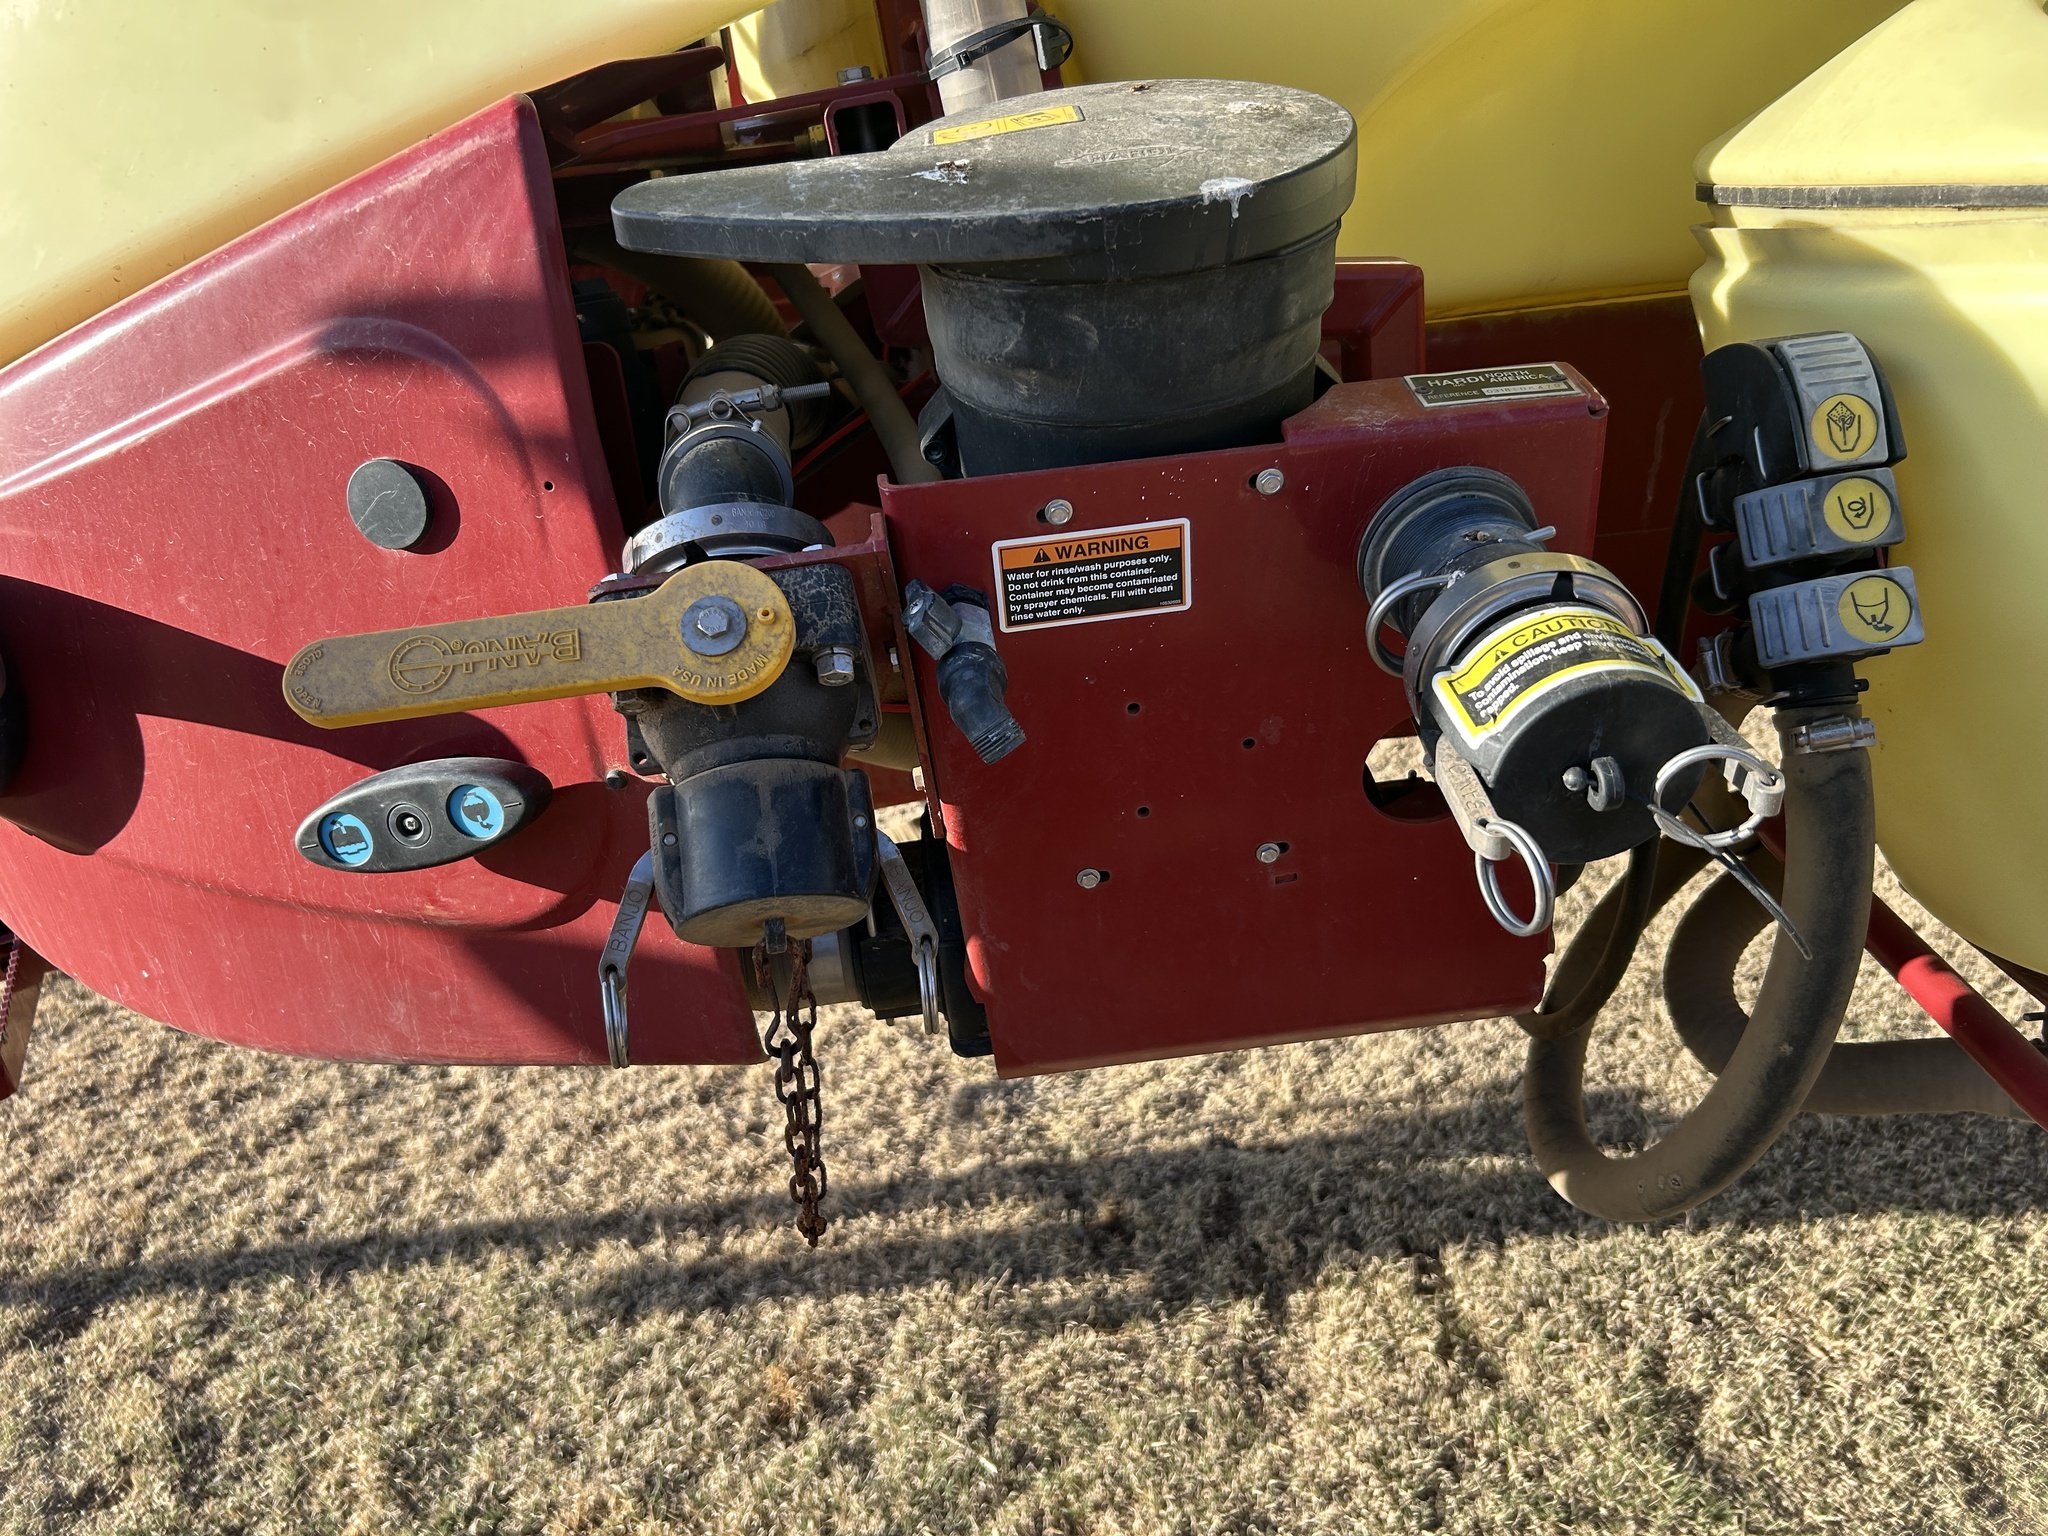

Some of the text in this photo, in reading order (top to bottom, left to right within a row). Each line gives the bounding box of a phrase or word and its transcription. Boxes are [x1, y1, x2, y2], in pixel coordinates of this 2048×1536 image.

[1427, 370, 1530, 387] HARDI NORTH
[1490, 374, 1549, 383] AMERICA
[1427, 390, 1480, 400] REFERENCE
[1055, 536, 1149, 560] WARNING
[1007, 554, 1172, 582] Water for rinse/wash purposes only.
[1008, 567, 1156, 592] Do not drink from this container.
[1009, 573, 1178, 602] Container may become contaminated
[1010, 585, 1173, 612] by sprayer chemicals. Fill with clean
[1011, 606, 1086, 621] rinse water only.
[1512, 618, 1621, 647] CAUTION
[294, 647, 325, 677] CLOSE
[671, 653, 770, 688] MADE IN USA
[1468, 690, 1485, 701] To
[1484, 663, 1511, 692] avoid
[1511, 641, 1557, 668] spillage
[1557, 631, 1582, 645] and
[1474, 654, 1552, 709] contamination,
[1551, 641, 1583, 656] keep
[295, 685, 323, 709] OPEN
[889, 865, 924, 923] BANJO
[609, 890, 644, 953] BANJO
